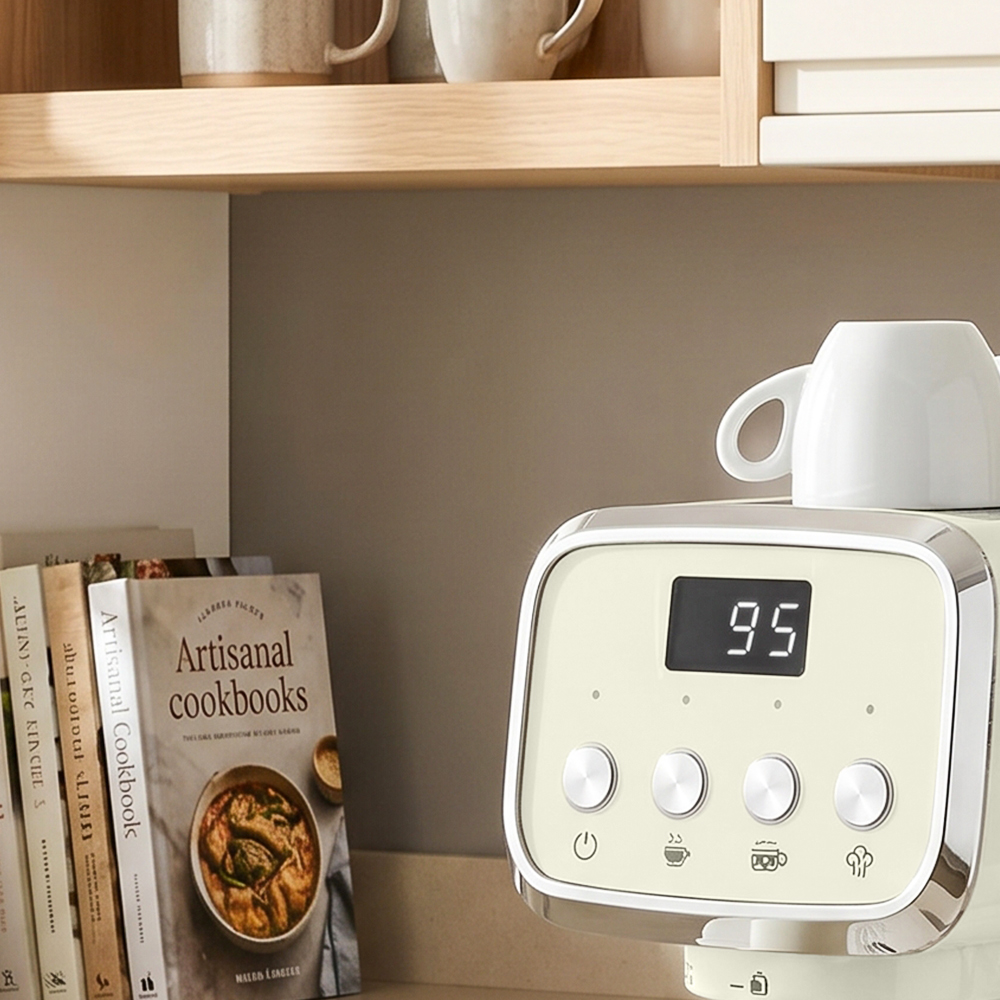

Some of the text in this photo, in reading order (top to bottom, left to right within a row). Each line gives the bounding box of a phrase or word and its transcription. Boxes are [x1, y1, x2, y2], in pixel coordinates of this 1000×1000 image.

[175, 629, 294, 673] Artisanal
[727, 601, 800, 658] 95
[100, 610, 129, 714] Artisanal
[169, 675, 309, 720] cookbooks
